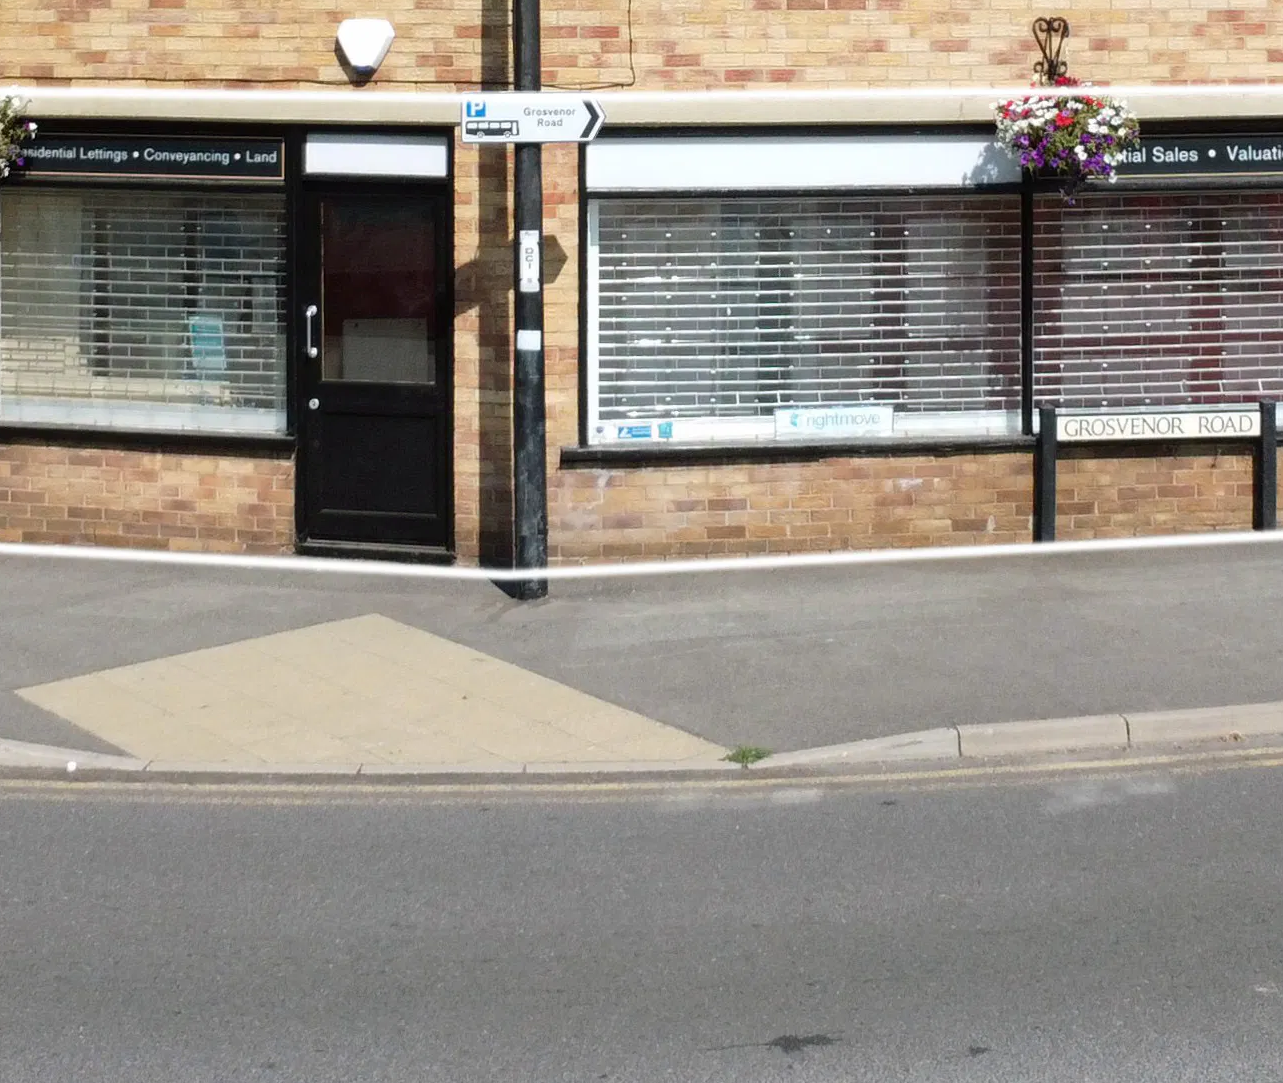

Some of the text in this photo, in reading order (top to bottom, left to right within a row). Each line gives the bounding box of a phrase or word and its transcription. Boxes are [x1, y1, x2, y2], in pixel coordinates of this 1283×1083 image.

[523, 106, 576, 117] Grosvenor
[536, 118, 563, 127] Road
[20, 146, 277, 165] esidential Lettings Conveyancing Land
[1152, 146, 1199, 162] Sales
[806, 412, 881, 430] rightmove
[1063, 414, 1253, 437] GROSVENOR ROAD
